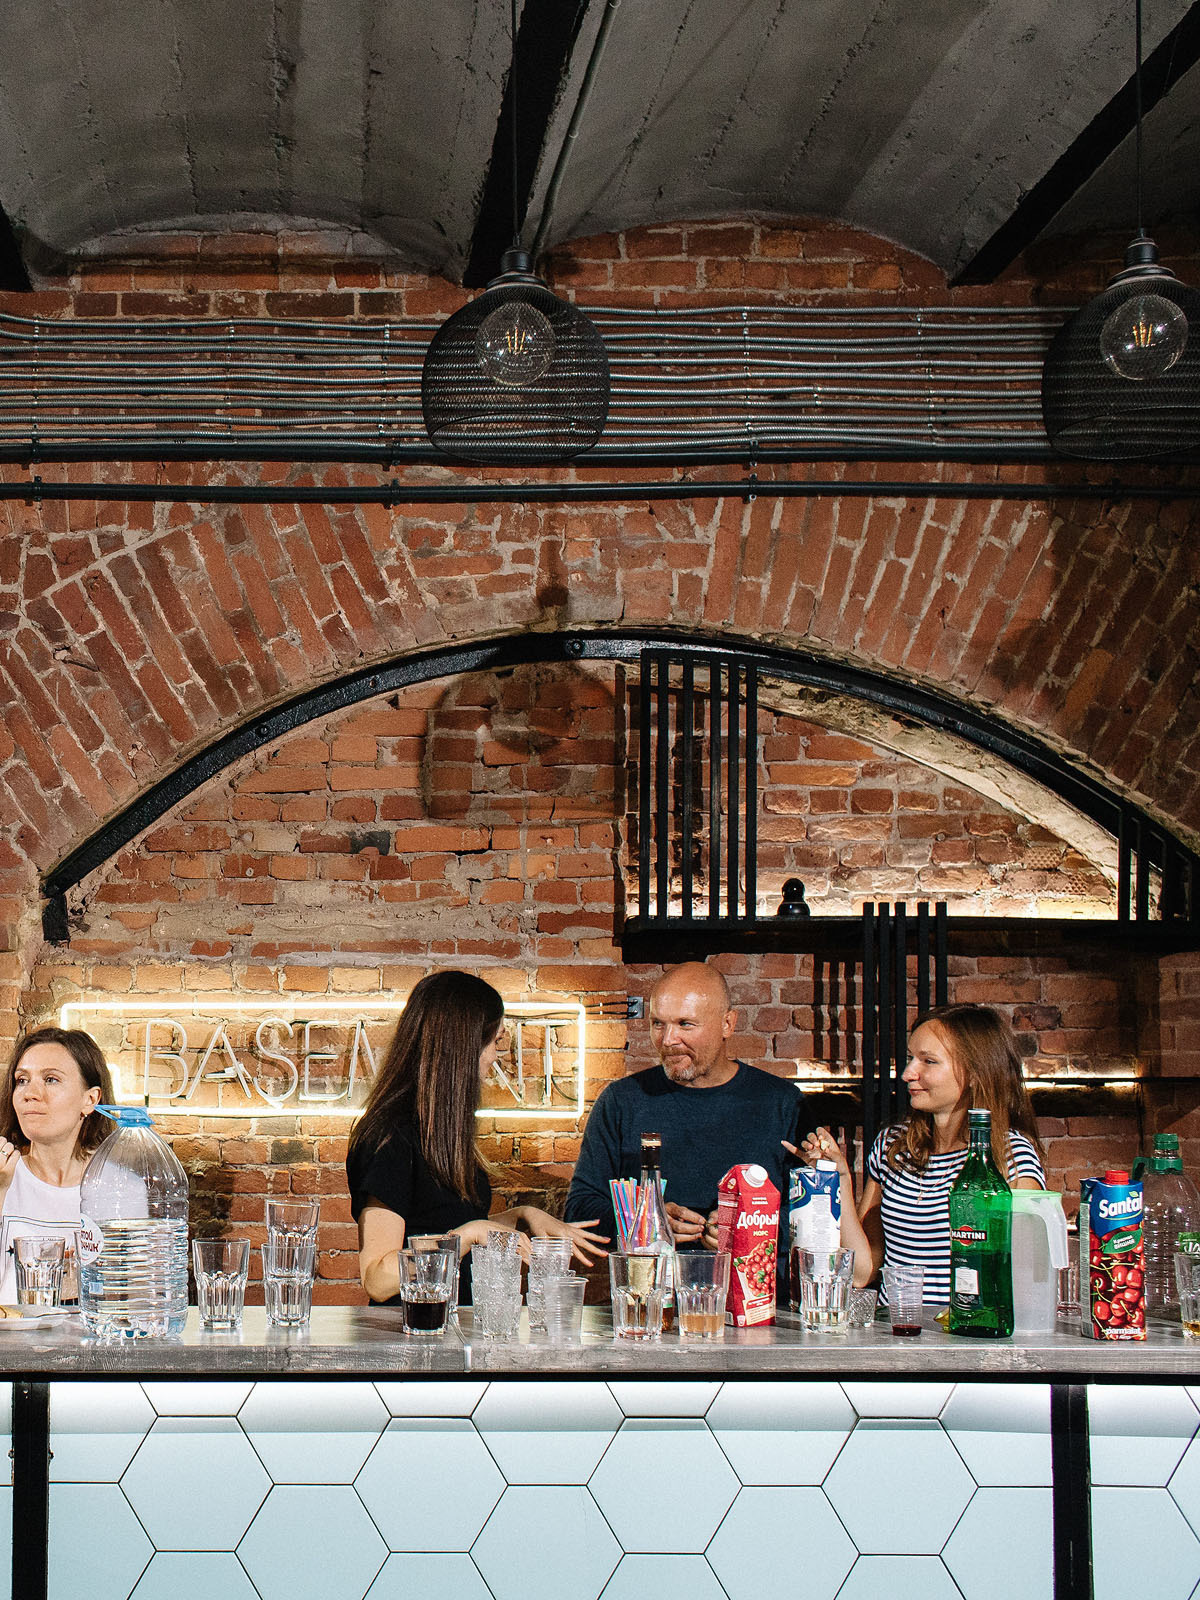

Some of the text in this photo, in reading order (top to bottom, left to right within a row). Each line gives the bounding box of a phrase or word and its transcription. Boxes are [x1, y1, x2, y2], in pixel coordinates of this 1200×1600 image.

[144, 1018, 573, 1102] BASENT
[1099, 1191, 1143, 1218] Santal
[737, 1210, 778, 1229] Добрый
[950, 1230, 986, 1241] MARTINI
